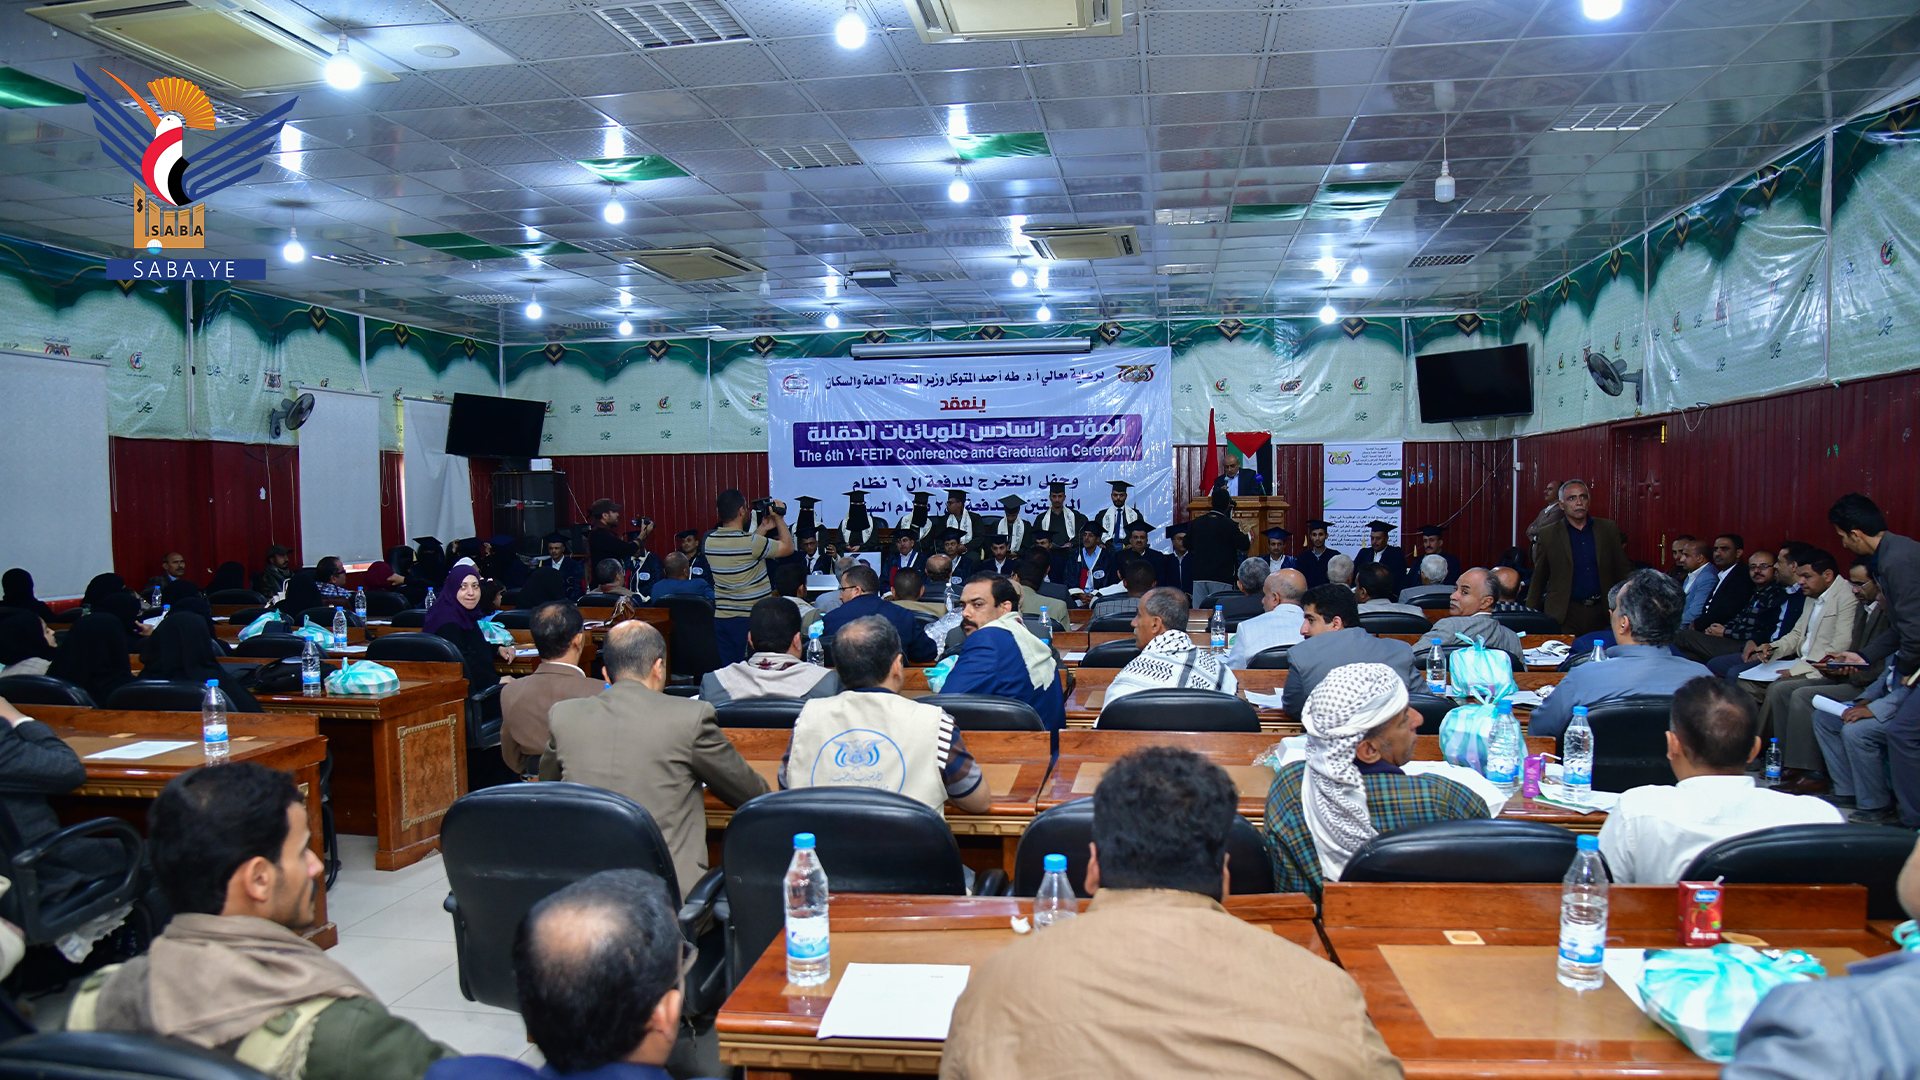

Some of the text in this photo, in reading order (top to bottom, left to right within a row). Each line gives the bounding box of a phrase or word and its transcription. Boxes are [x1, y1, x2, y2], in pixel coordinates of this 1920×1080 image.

[825, 375, 861, 390] والسكان
[862, 374, 891, 386] العامة
[893, 373, 922, 385] الصحة
[924, 373, 945, 388] وزير
[946, 371, 977, 386] المتوكل
[979, 370, 1002, 382] أحمد
[1004, 370, 1020, 382] طه
[1041, 368, 1068, 386] معالي
[939, 396, 987, 413] ينعقد
[807, 417, 1126, 445] المؤتمر السادس للوبائيات الحقلية
[800, 443, 1138, 462] The 6th Y-FETP Conference and Graduation Ceremony
[852, 475, 887, 491] نظام
[906, 476, 922, 491] ال
[926, 474, 973, 488] للدفعة
[978, 474, 1032, 490] التخرج
